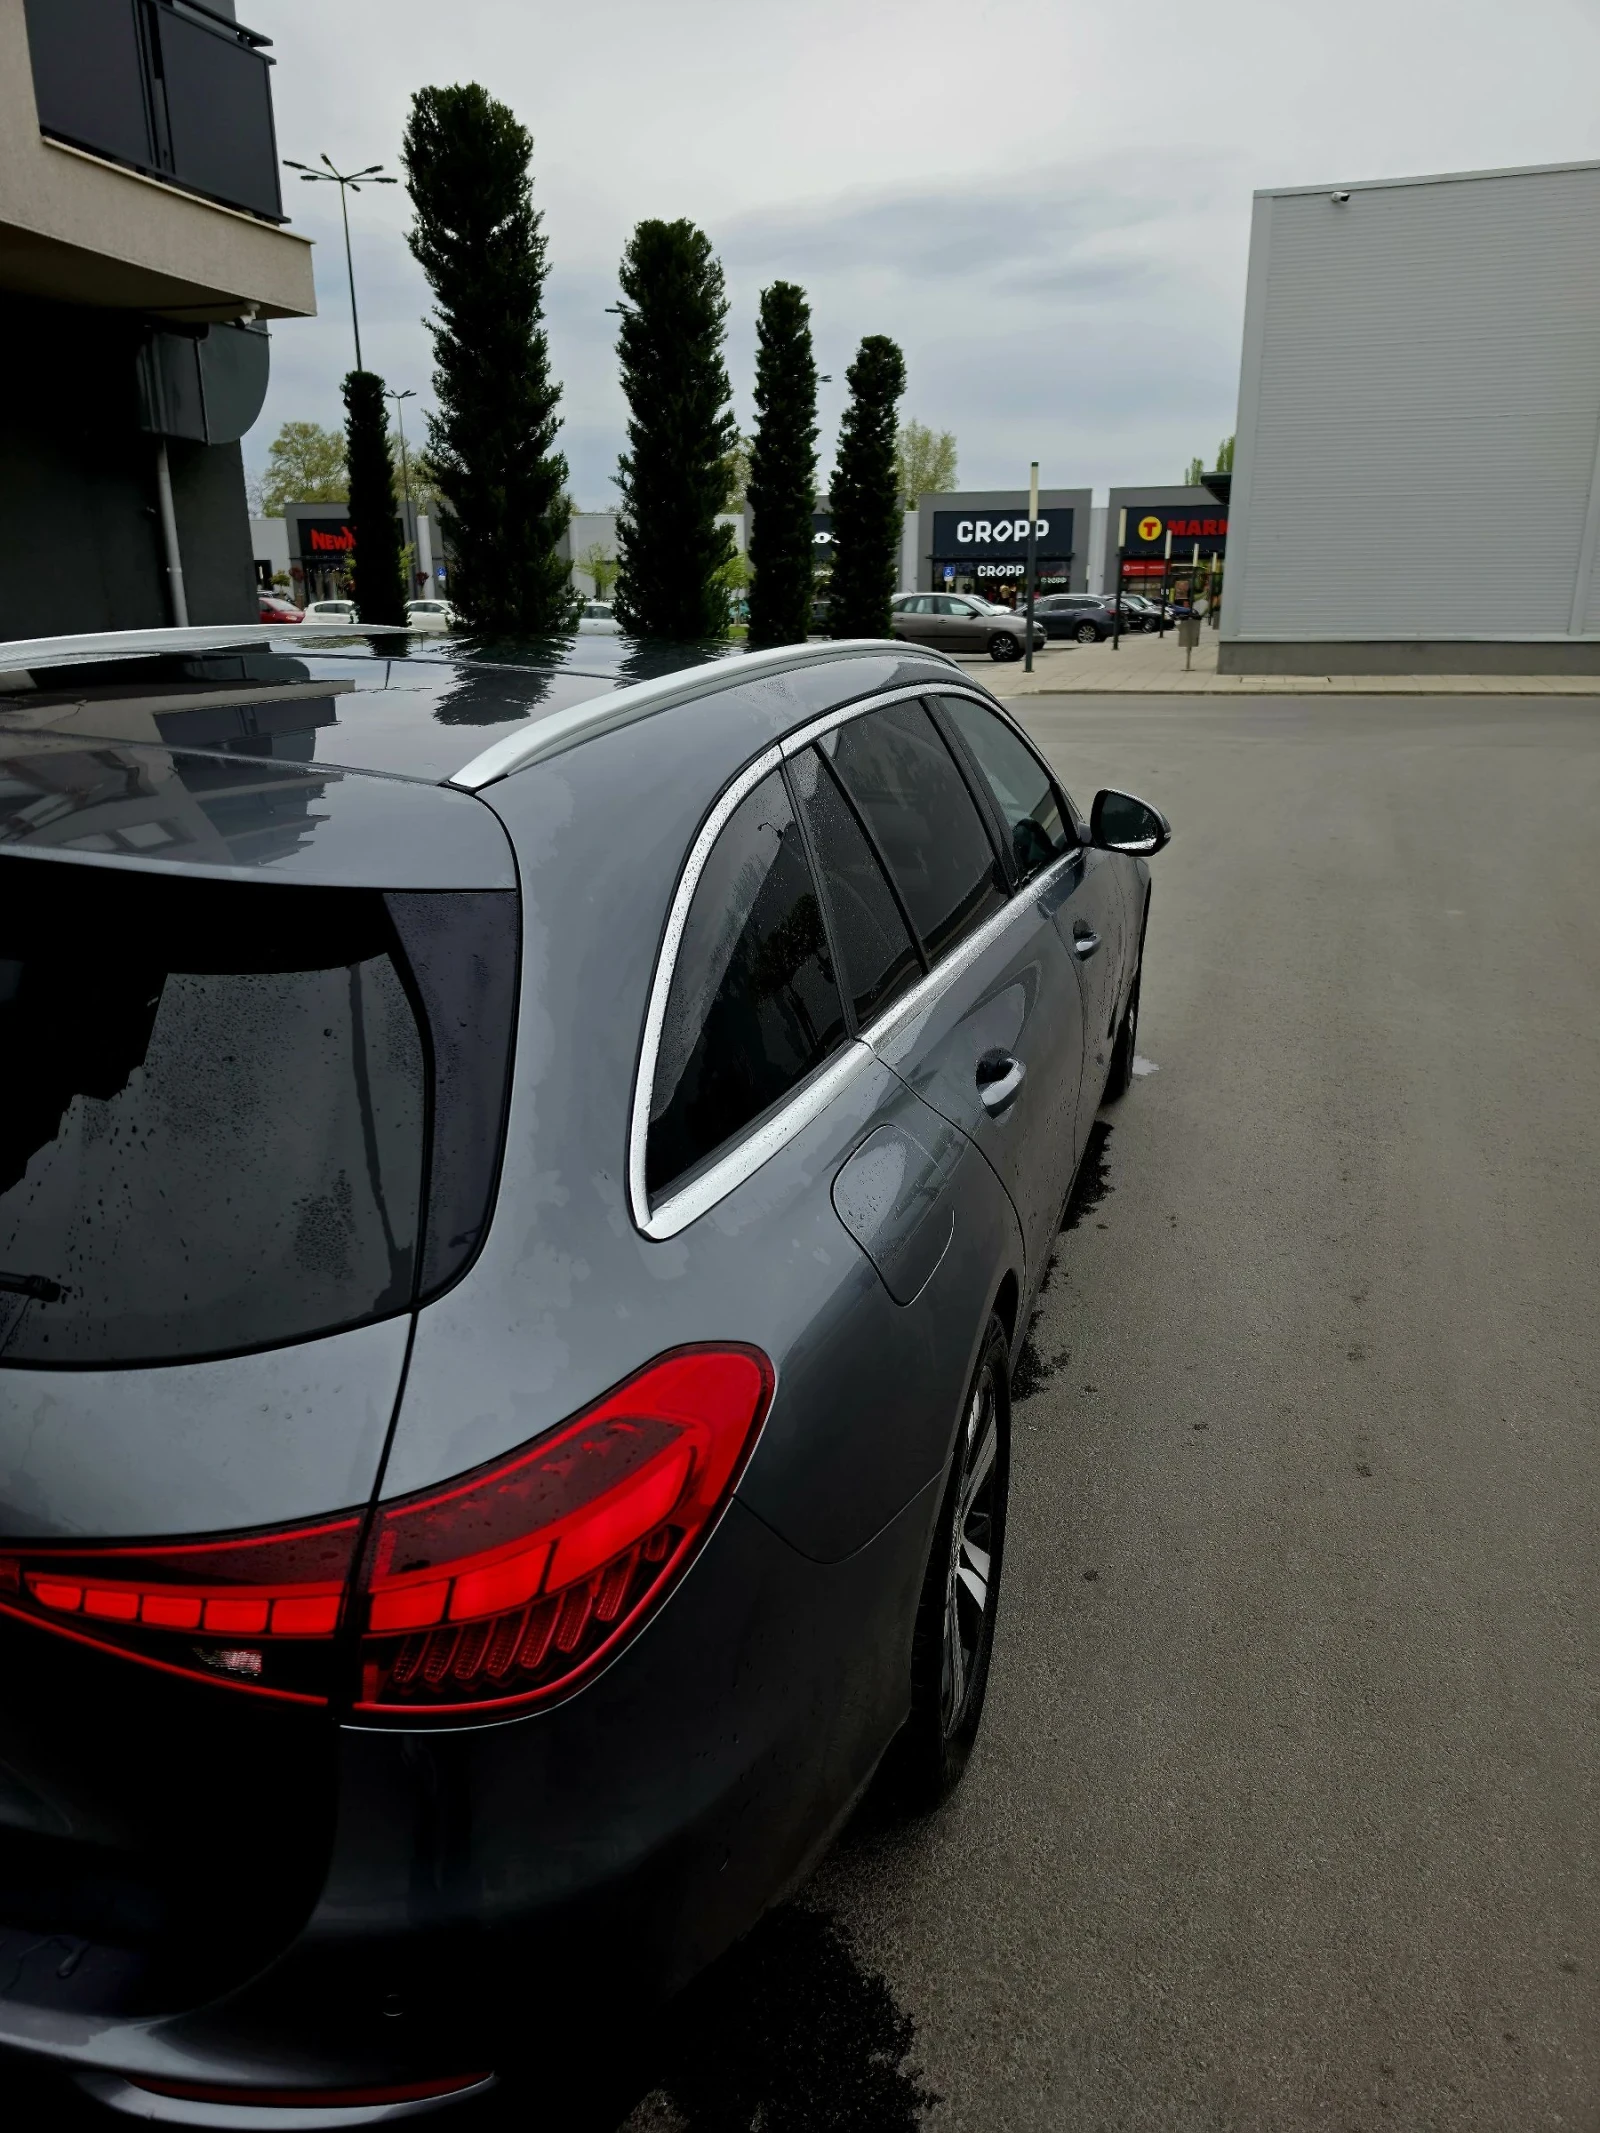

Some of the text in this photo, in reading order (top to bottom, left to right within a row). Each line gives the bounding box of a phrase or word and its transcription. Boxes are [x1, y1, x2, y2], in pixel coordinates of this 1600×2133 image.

[957, 519, 1050, 543] CROPP
[1143, 522, 1157, 537] T
[977, 565, 1025, 577] CROPP
